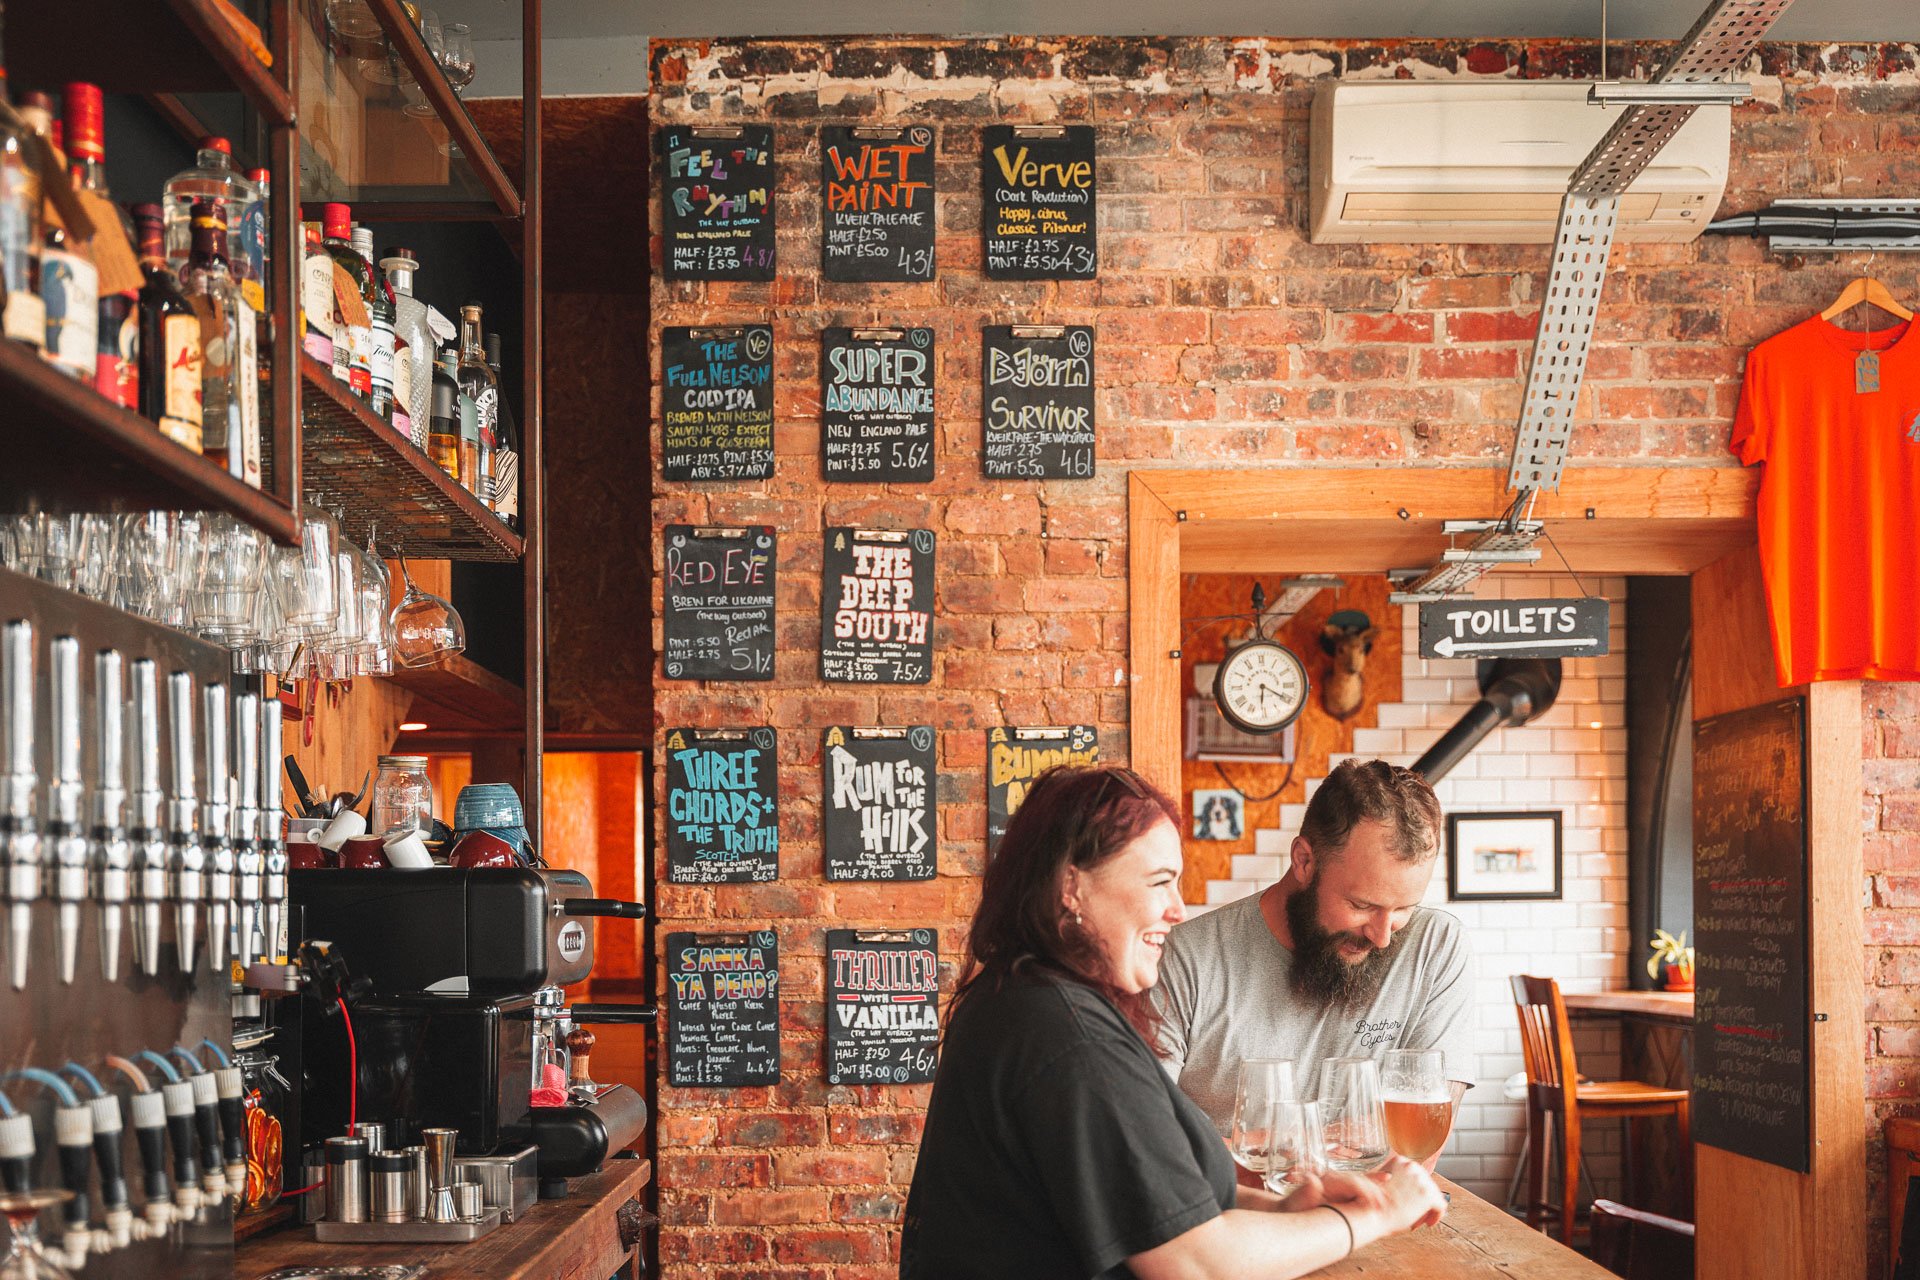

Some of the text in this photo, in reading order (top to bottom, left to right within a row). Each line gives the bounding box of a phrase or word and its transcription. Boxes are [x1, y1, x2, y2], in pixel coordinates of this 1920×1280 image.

[670, 148, 768, 180] FEEL THE
[827, 145, 925, 181] WET
[993, 144, 1092, 188] Verve
[828, 181, 932, 212] PAINT
[1032, 188, 1089, 204] Revolution)
[997, 222, 1086, 235] Classic Pilsner!
[674, 247, 705, 258] HALF:
[1025, 239, 1059, 253] £2.75
[708, 259, 740, 270] £5.50
[701, 340, 737, 361] THE
[667, 362, 770, 387] FULL NELSON
[829, 347, 926, 386] SUPER
[684, 388, 756, 410] COLD IPA
[826, 383, 934, 413] ABUNDANCE
[667, 409, 771, 424] BREWED WITH NELSON
[667, 426, 702, 437] SAUVIN
[736, 424, 770, 436] EXPECT
[827, 423, 928, 438] NEW ENGLAND PALE
[667, 438, 698, 448] HINTS
[699, 436, 713, 447] OF
[891, 442, 930, 468] 5.6%
[746, 462, 767, 475] ABV
[667, 547, 767, 587] RED EYE
[852, 545, 913, 578] THE
[672, 596, 774, 608] BREW FOR UKRAINE
[839, 575, 913, 611] DEEP
[834, 609, 929, 644] SOUTH
[1446, 606, 1577, 638] TOILETS
[697, 636, 720, 647] 5.50
[697, 649, 721, 659] 2.75
[673, 748, 761, 790] THREE
[830, 745, 927, 811] RUM FOR
[670, 788, 763, 828] CHORDS
[895, 787, 926, 808] THE
[678, 824, 778, 853] THE TRUTH
[695, 849, 741, 862] SCOTCH
[906, 865, 933, 877] 9.2%
[681, 948, 765, 972] SANKA
[832, 949, 938, 992] THRILLER
[670, 970, 779, 1000] YA DEAD?
[861, 994, 889, 1003] WITH
[836, 1004, 938, 1030] VANILLA
[1354, 1018, 1401, 1034] Brother
[1361, 1031, 1395, 1049] Cycles
[837, 1063, 857, 1075] PINT
